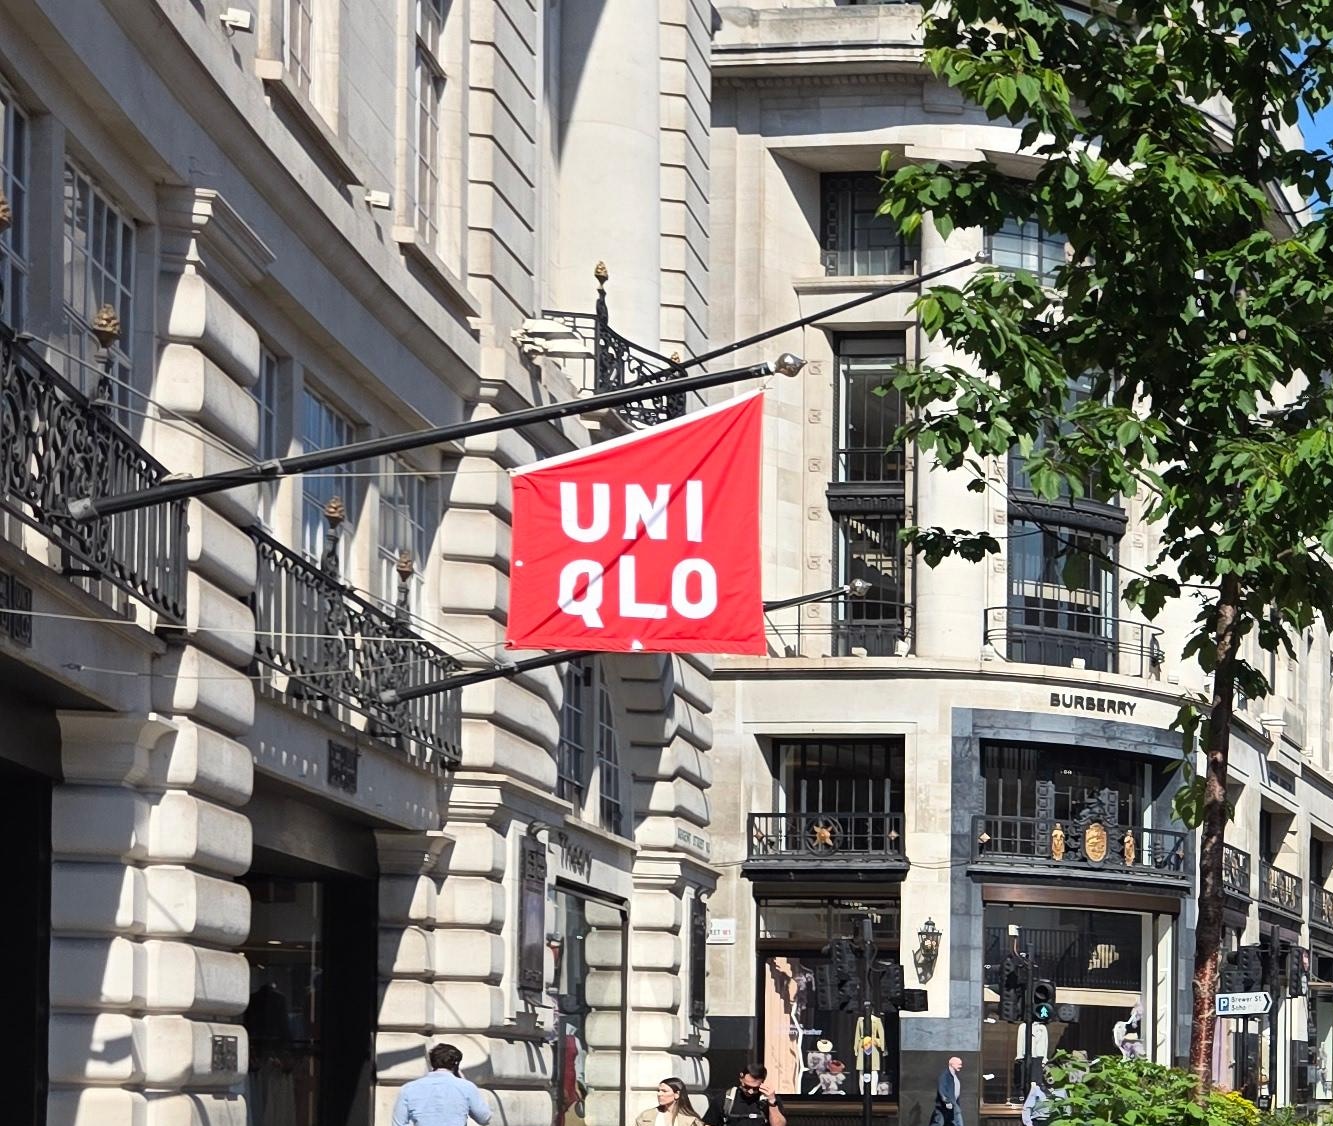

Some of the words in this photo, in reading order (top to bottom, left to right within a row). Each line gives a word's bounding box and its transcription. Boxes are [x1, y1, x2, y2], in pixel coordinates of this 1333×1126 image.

[559, 479, 704, 544] UNI
[556, 554, 719, 629] QLO
[1050, 692, 1137, 717] BURBERRY
[1231, 995, 1253, 1003] Brewer
